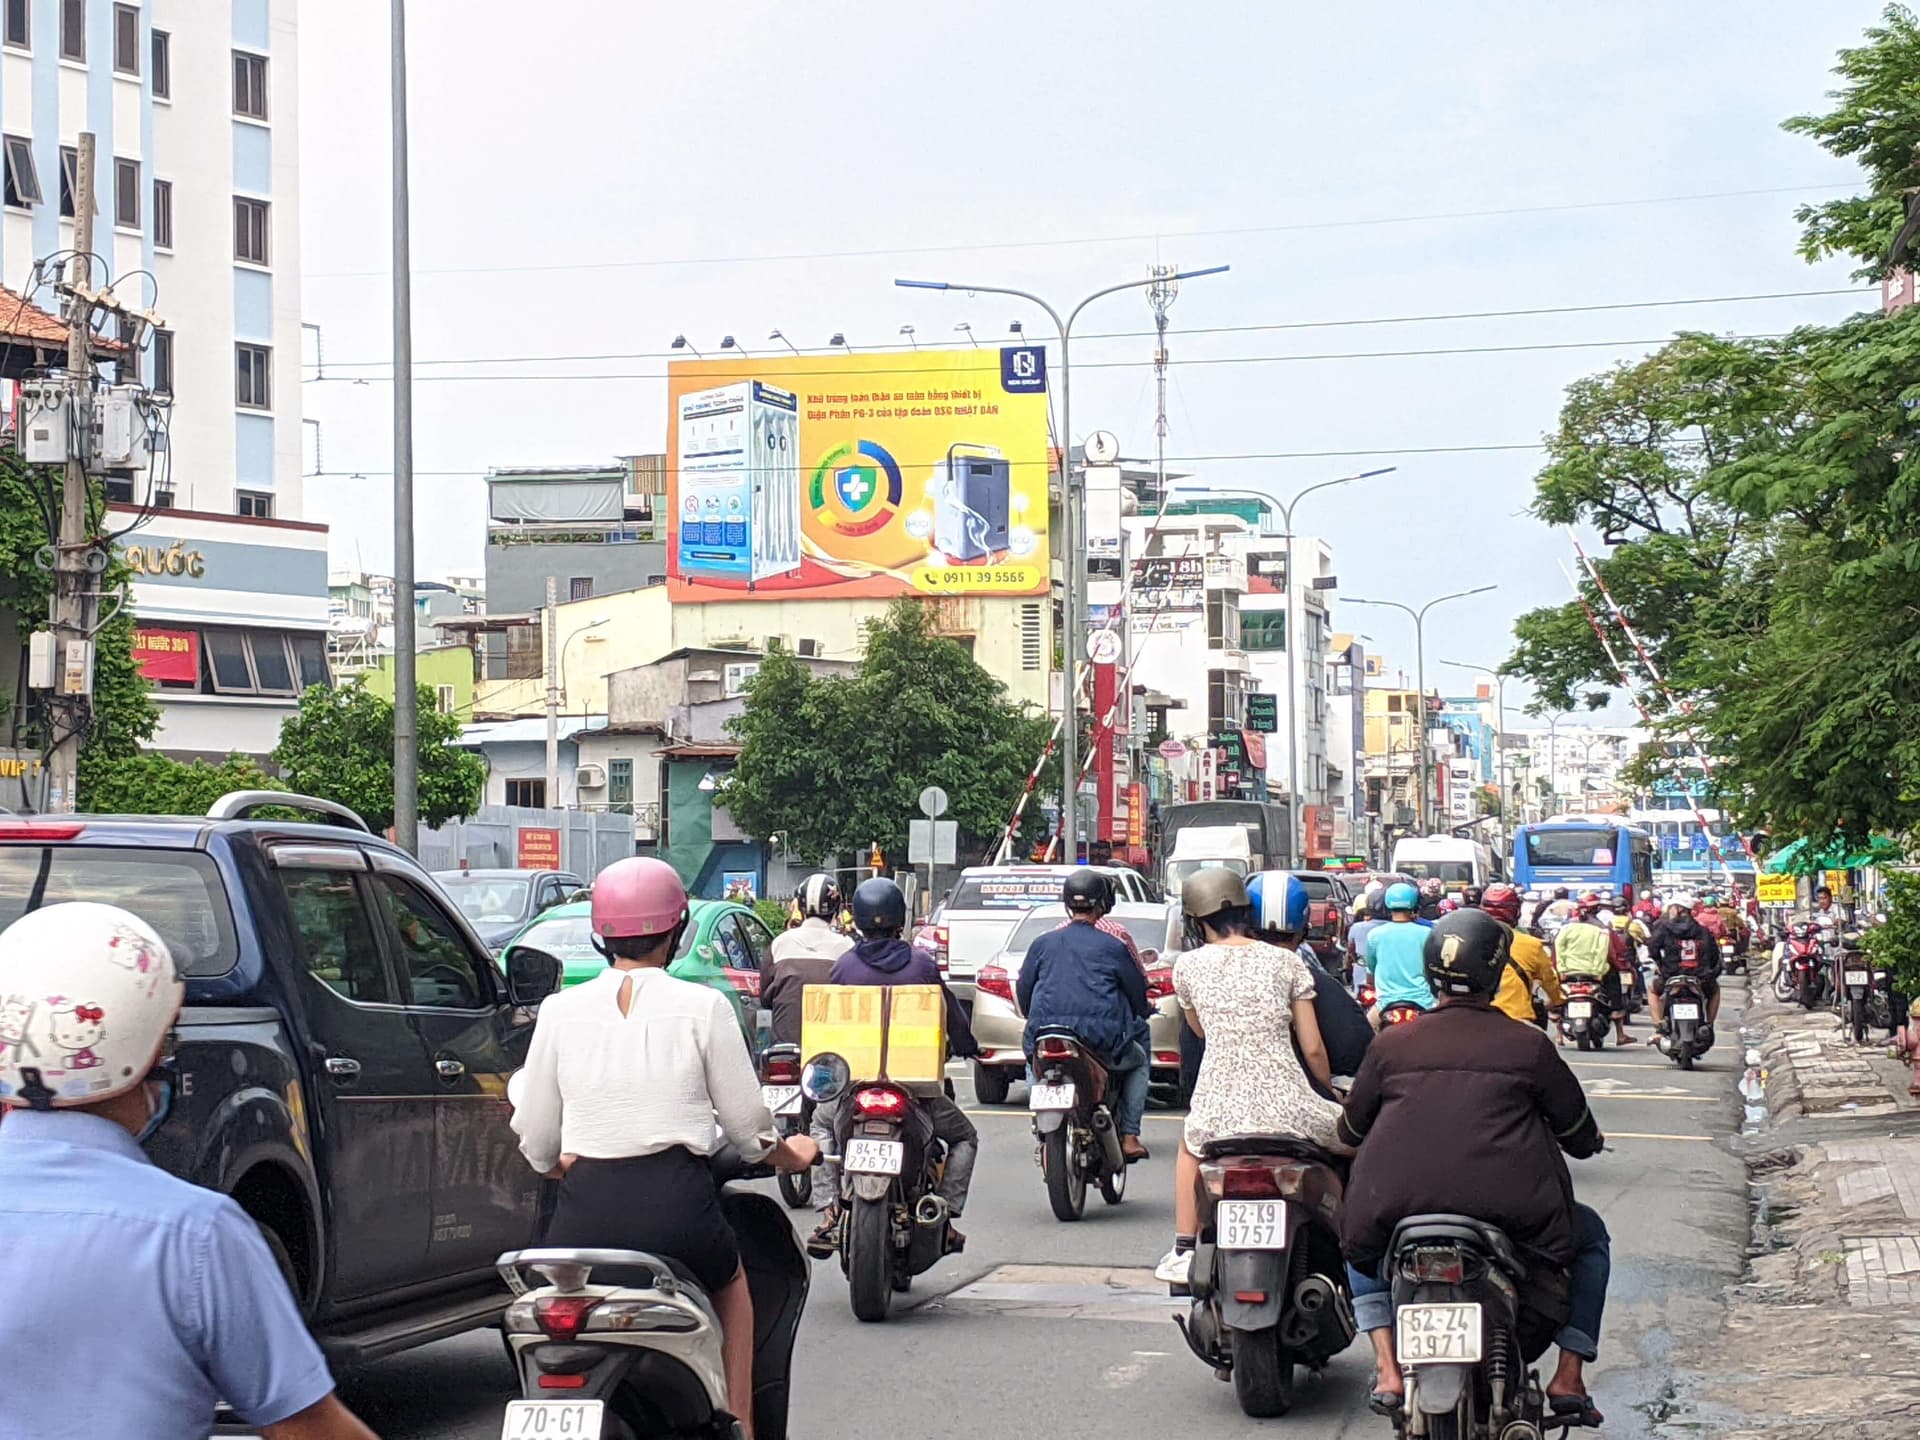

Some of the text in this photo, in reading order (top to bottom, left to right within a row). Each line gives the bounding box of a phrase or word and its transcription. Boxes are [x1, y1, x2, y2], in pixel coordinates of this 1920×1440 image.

[126, 540, 205, 578] QUỐC
[943, 572, 972, 584] 0911
[976, 572, 991, 583] 39
[849, 1156, 897, 1171] 27679
[1229, 1204, 1275, 1223] 52-K9
[1228, 1225, 1275, 1245] 9757
[1411, 1333, 1466, 1357] 3971
[521, 1406, 585, 1434] 70-G1
